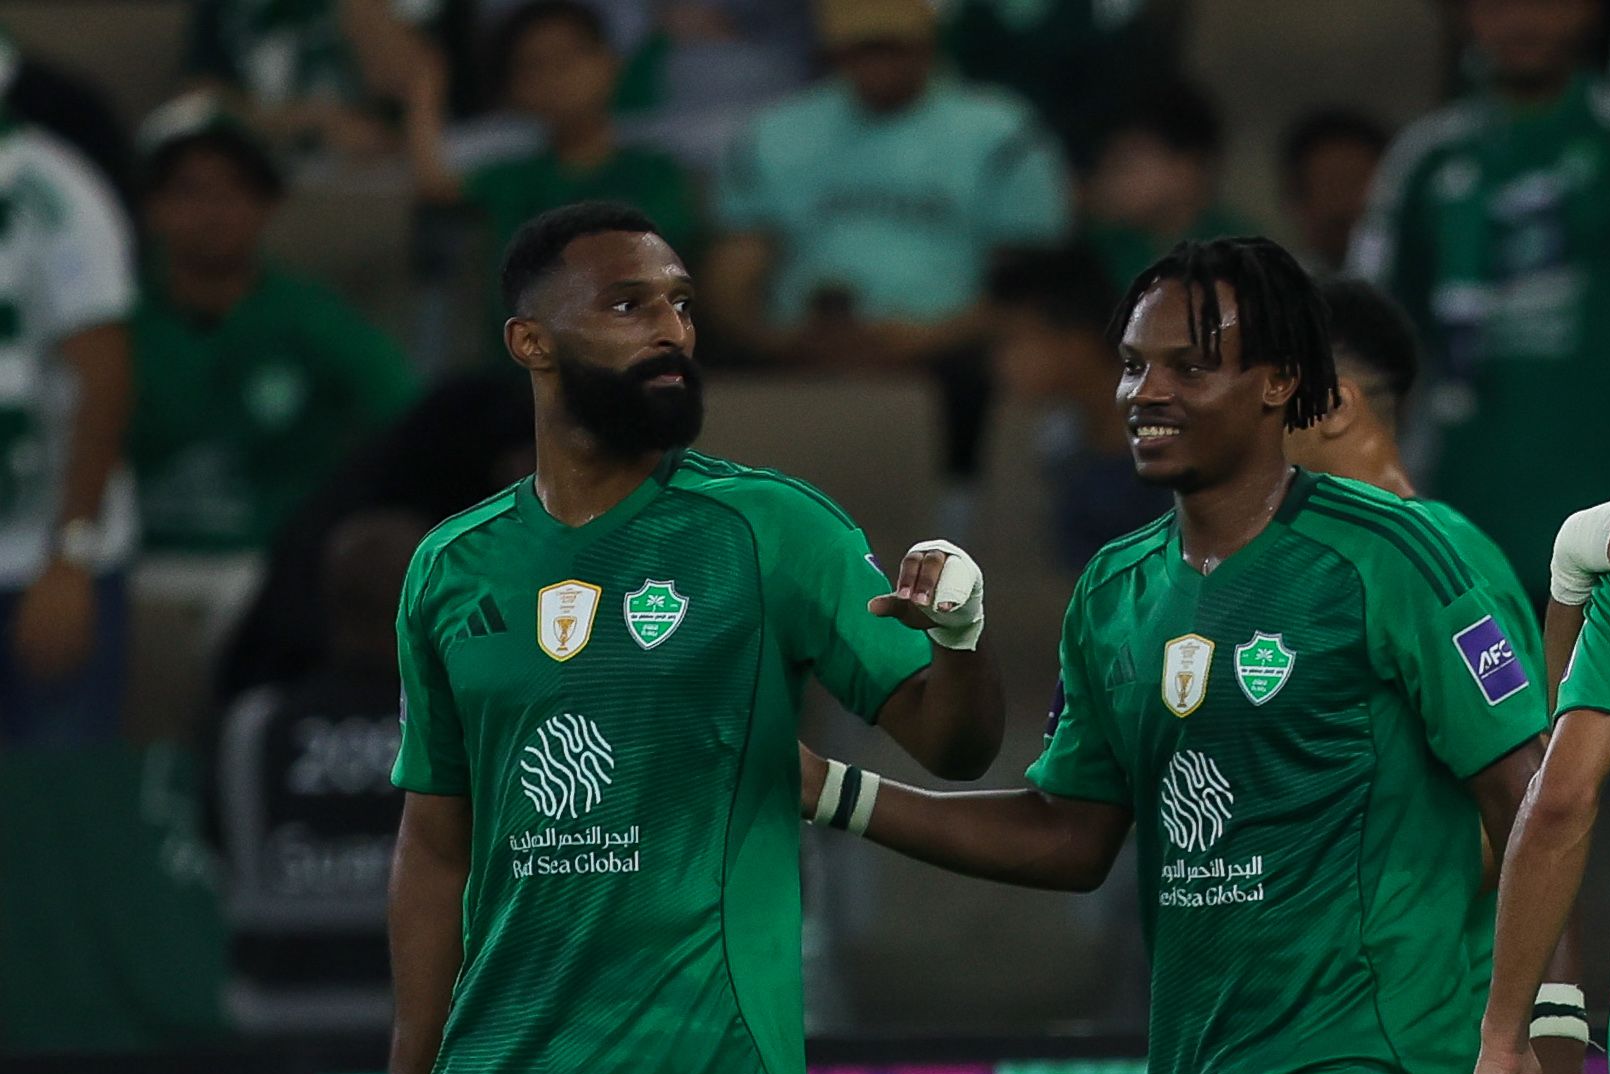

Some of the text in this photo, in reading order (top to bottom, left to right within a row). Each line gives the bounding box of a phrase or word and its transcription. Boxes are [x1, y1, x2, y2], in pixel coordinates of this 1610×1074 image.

[1479, 639, 1513, 675] AFC
[602, 825, 640, 850] البحر
[537, 855, 571, 875] Sea
[574, 850, 640, 874] Global
[1225, 855, 1264, 882] البحر
[1205, 882, 1265, 907] Global
